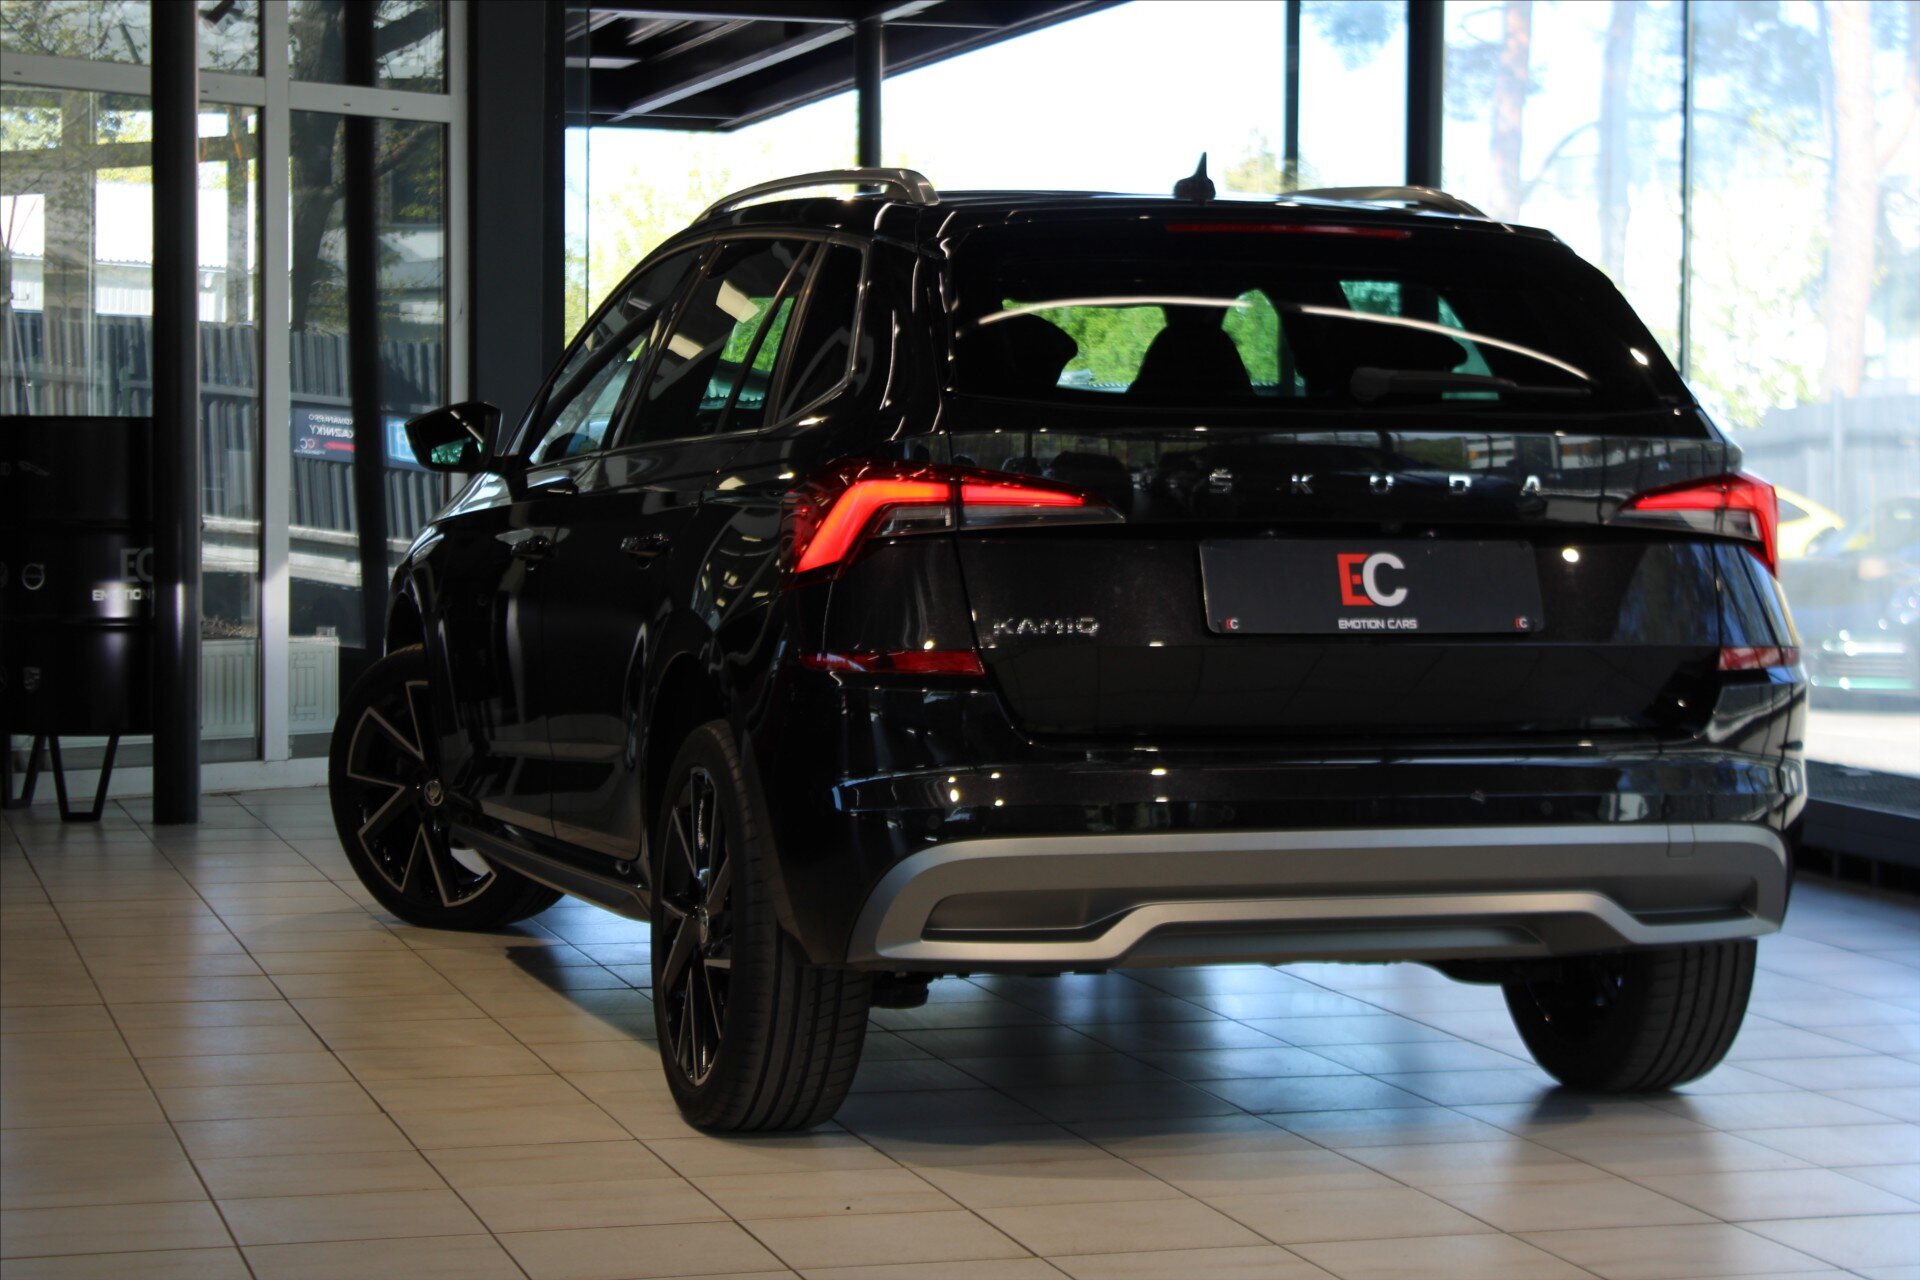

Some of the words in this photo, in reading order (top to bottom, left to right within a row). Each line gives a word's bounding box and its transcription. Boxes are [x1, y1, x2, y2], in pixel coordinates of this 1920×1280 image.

[1337, 552, 1408, 607] EC
[993, 618, 1099, 636] KAMIQ
[1338, 618, 1385, 629] EMOTION
[1387, 618, 1418, 629] CARS
